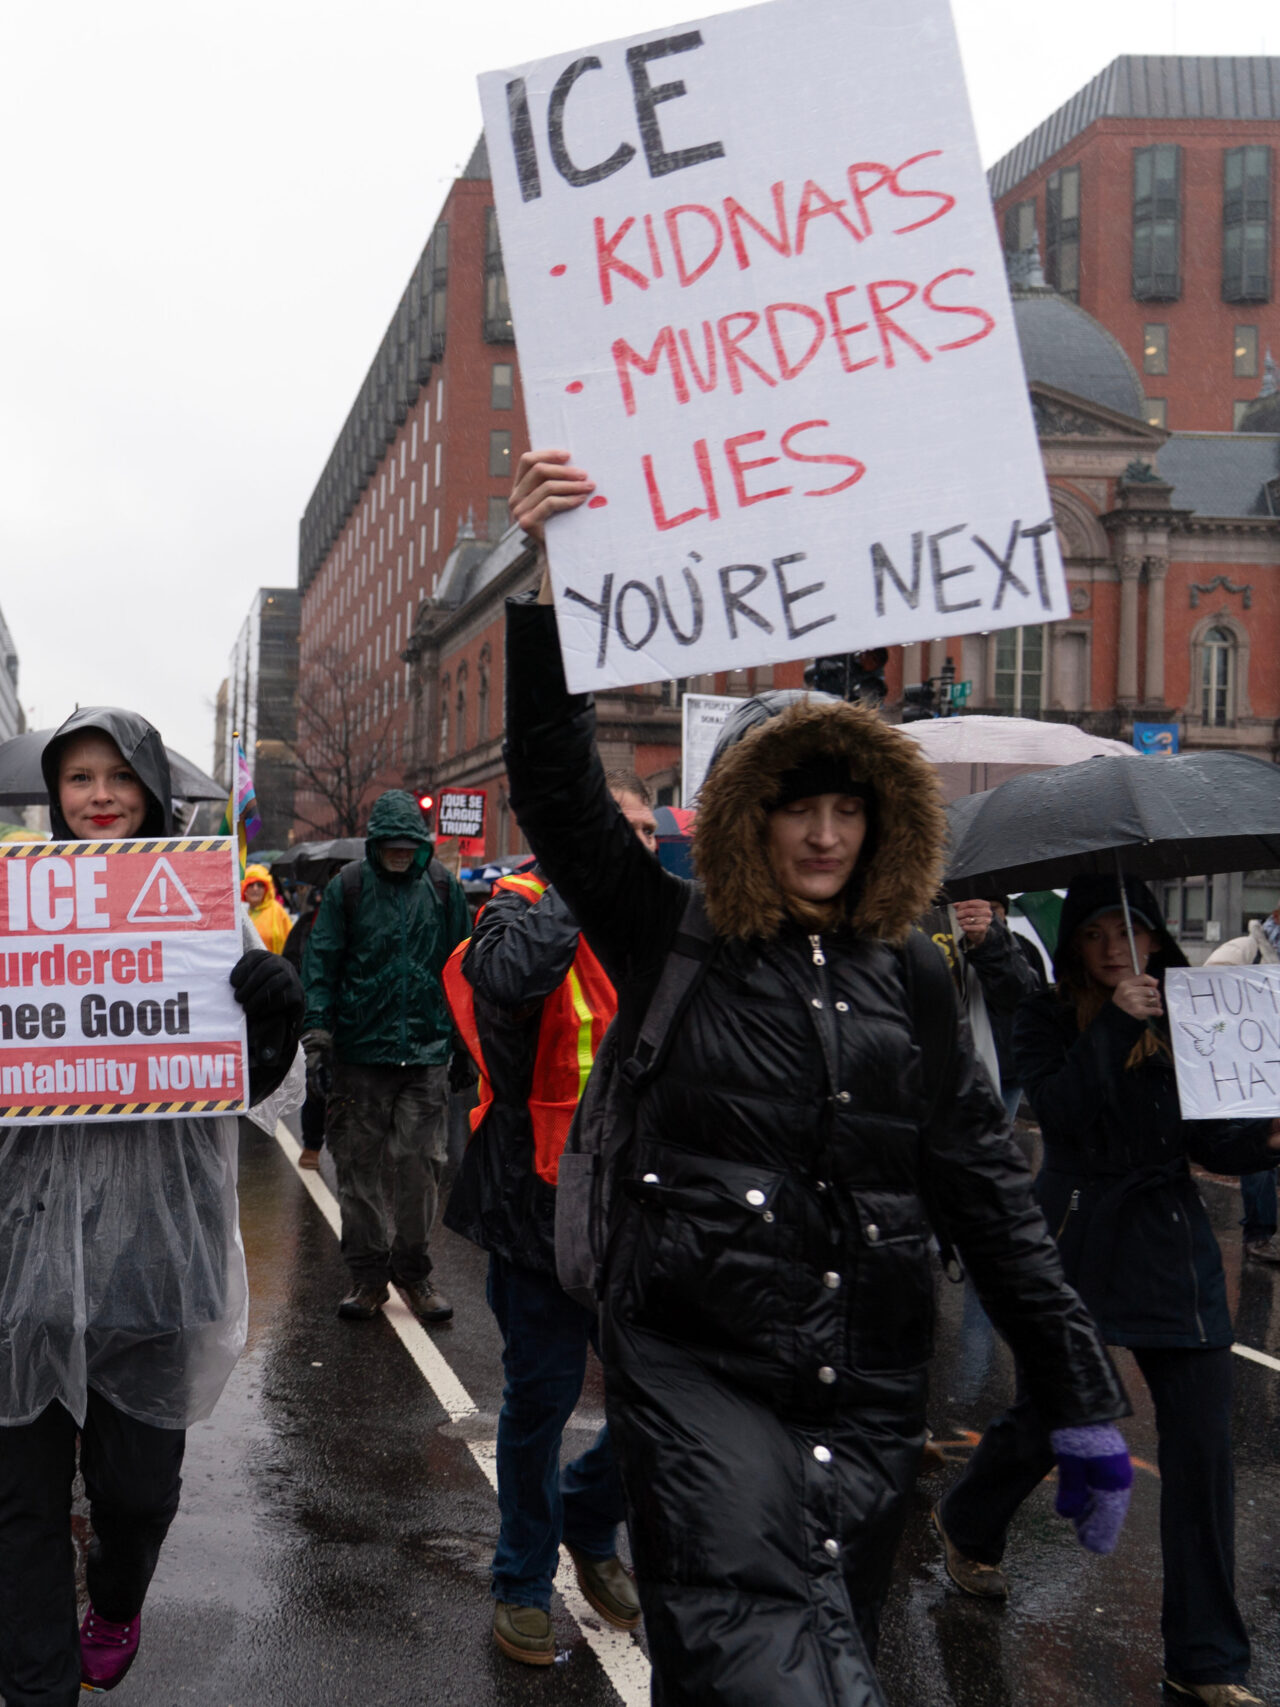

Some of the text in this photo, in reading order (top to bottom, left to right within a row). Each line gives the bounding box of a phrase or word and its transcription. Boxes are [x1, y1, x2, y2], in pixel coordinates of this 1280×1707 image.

[505, 30, 725, 203] ICE
[593, 149, 956, 305] KIDNAPS
[611, 268, 996, 417] MURDERS
[641, 419, 867, 531] LIES
[563, 517, 1054, 669] YOU'RE NEXT
[440, 807, 482, 823] LARGUE
[468, 794, 483, 809] SE
[441, 820, 480, 836] TRUMP
[7, 856, 111, 932] ICE
[80, 992, 190, 1038] Good
[1187, 977, 1280, 1015] HUM
[1239, 1019, 1280, 1052] OV
[147, 1053, 236, 1091] NOW!
